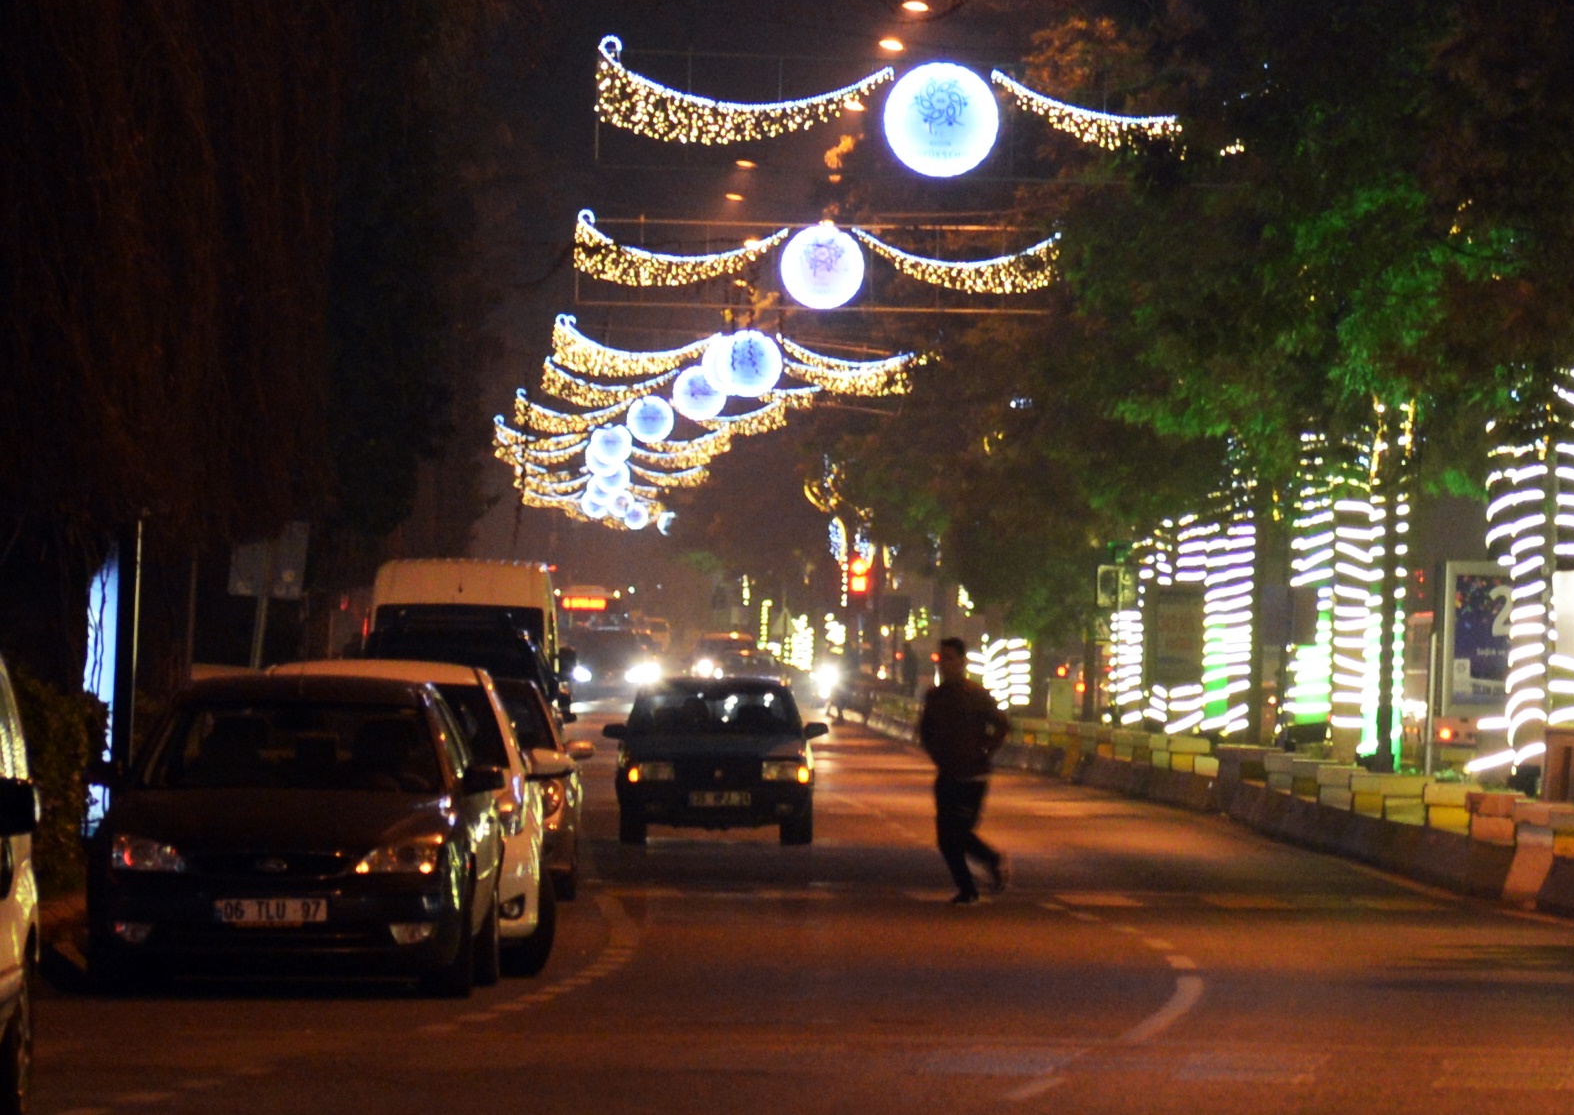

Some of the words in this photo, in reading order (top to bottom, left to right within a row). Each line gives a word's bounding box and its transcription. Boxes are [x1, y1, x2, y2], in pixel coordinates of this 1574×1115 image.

[224, 900, 245, 920] 06
[256, 900, 287, 920] TLU
[301, 900, 322, 920] 97
